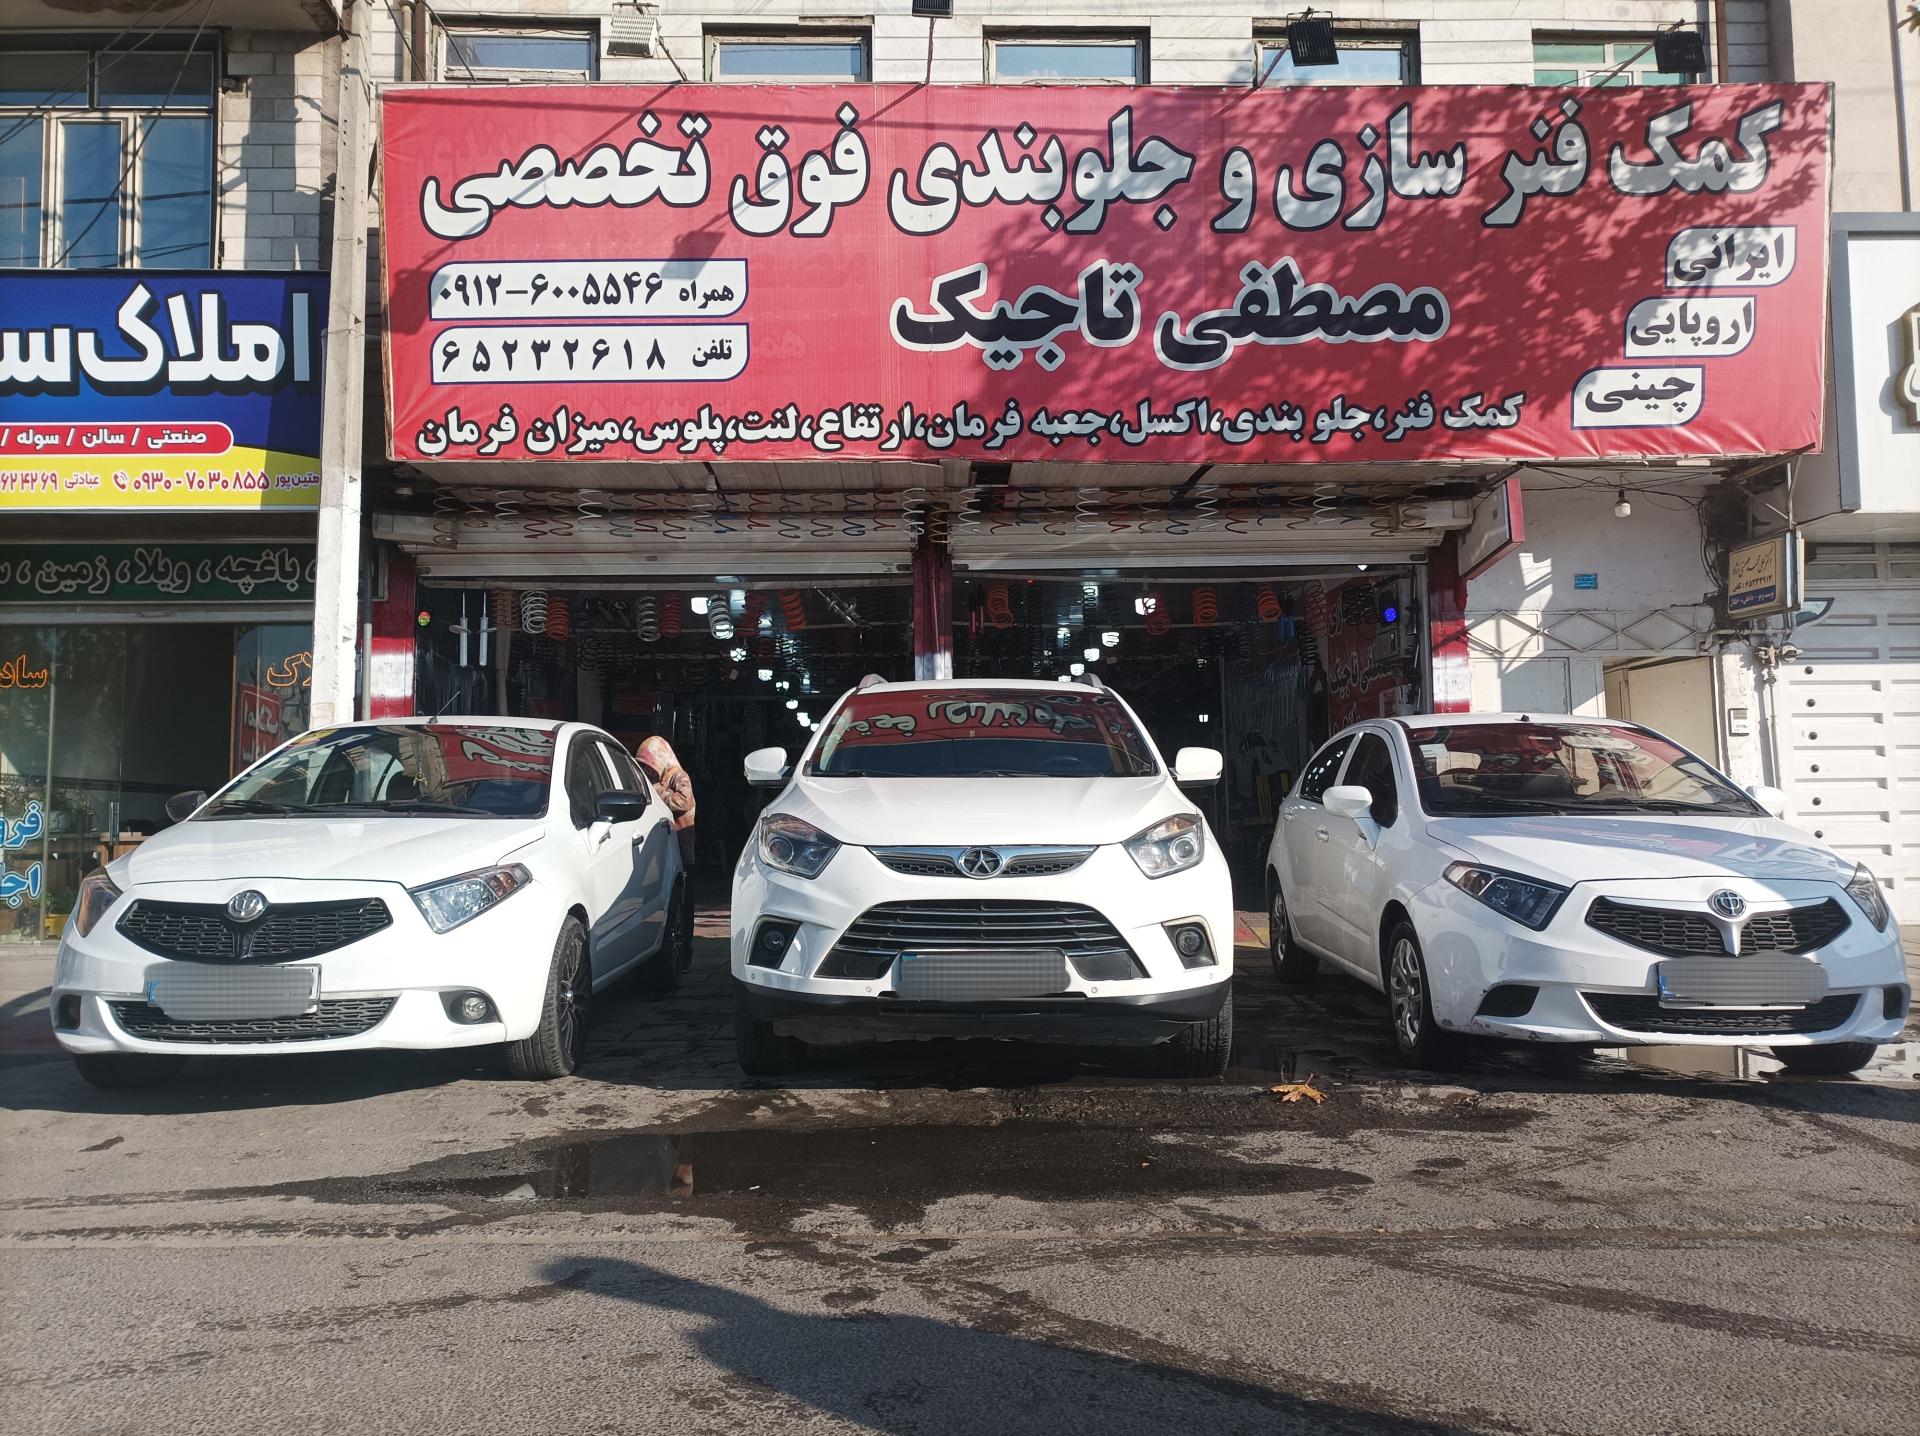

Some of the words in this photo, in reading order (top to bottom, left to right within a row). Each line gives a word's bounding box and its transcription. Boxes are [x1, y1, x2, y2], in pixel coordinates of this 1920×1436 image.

[729, 101, 871, 238] فوق
[887, 105, 1196, 234] جلوبندی
[1275, 101, 1468, 232] سازی
[1482, 98, 1591, 228] فنر
[1608, 100, 1785, 196] کمک
[419, 109, 712, 239] تخصصی
[1211, 146, 1257, 233] و
[1673, 232, 1785, 282] ایرانی
[679, 279, 735, 309] همراه
[889, 258, 1143, 372] تاجیک
[1153, 255, 1451, 372] مصطفی
[78, 283, 310, 382] املاک
[1630, 301, 1752, 347] اروپایی
[692, 338, 732, 367] تلفن
[1442, 391, 1528, 431] کمک
[1585, 372, 1696, 414] چینی
[16, 428, 60, 450] سوله
[82, 428, 125, 448] سالن
[147, 429, 207, 450] صنعتی
[416, 403, 520, 456] فرمان
[523, 405, 621, 454] میزان
[1029, 407, 1108, 447] جعبه
[0, 472, 57, 490] ۶۲۴۲۶۹
